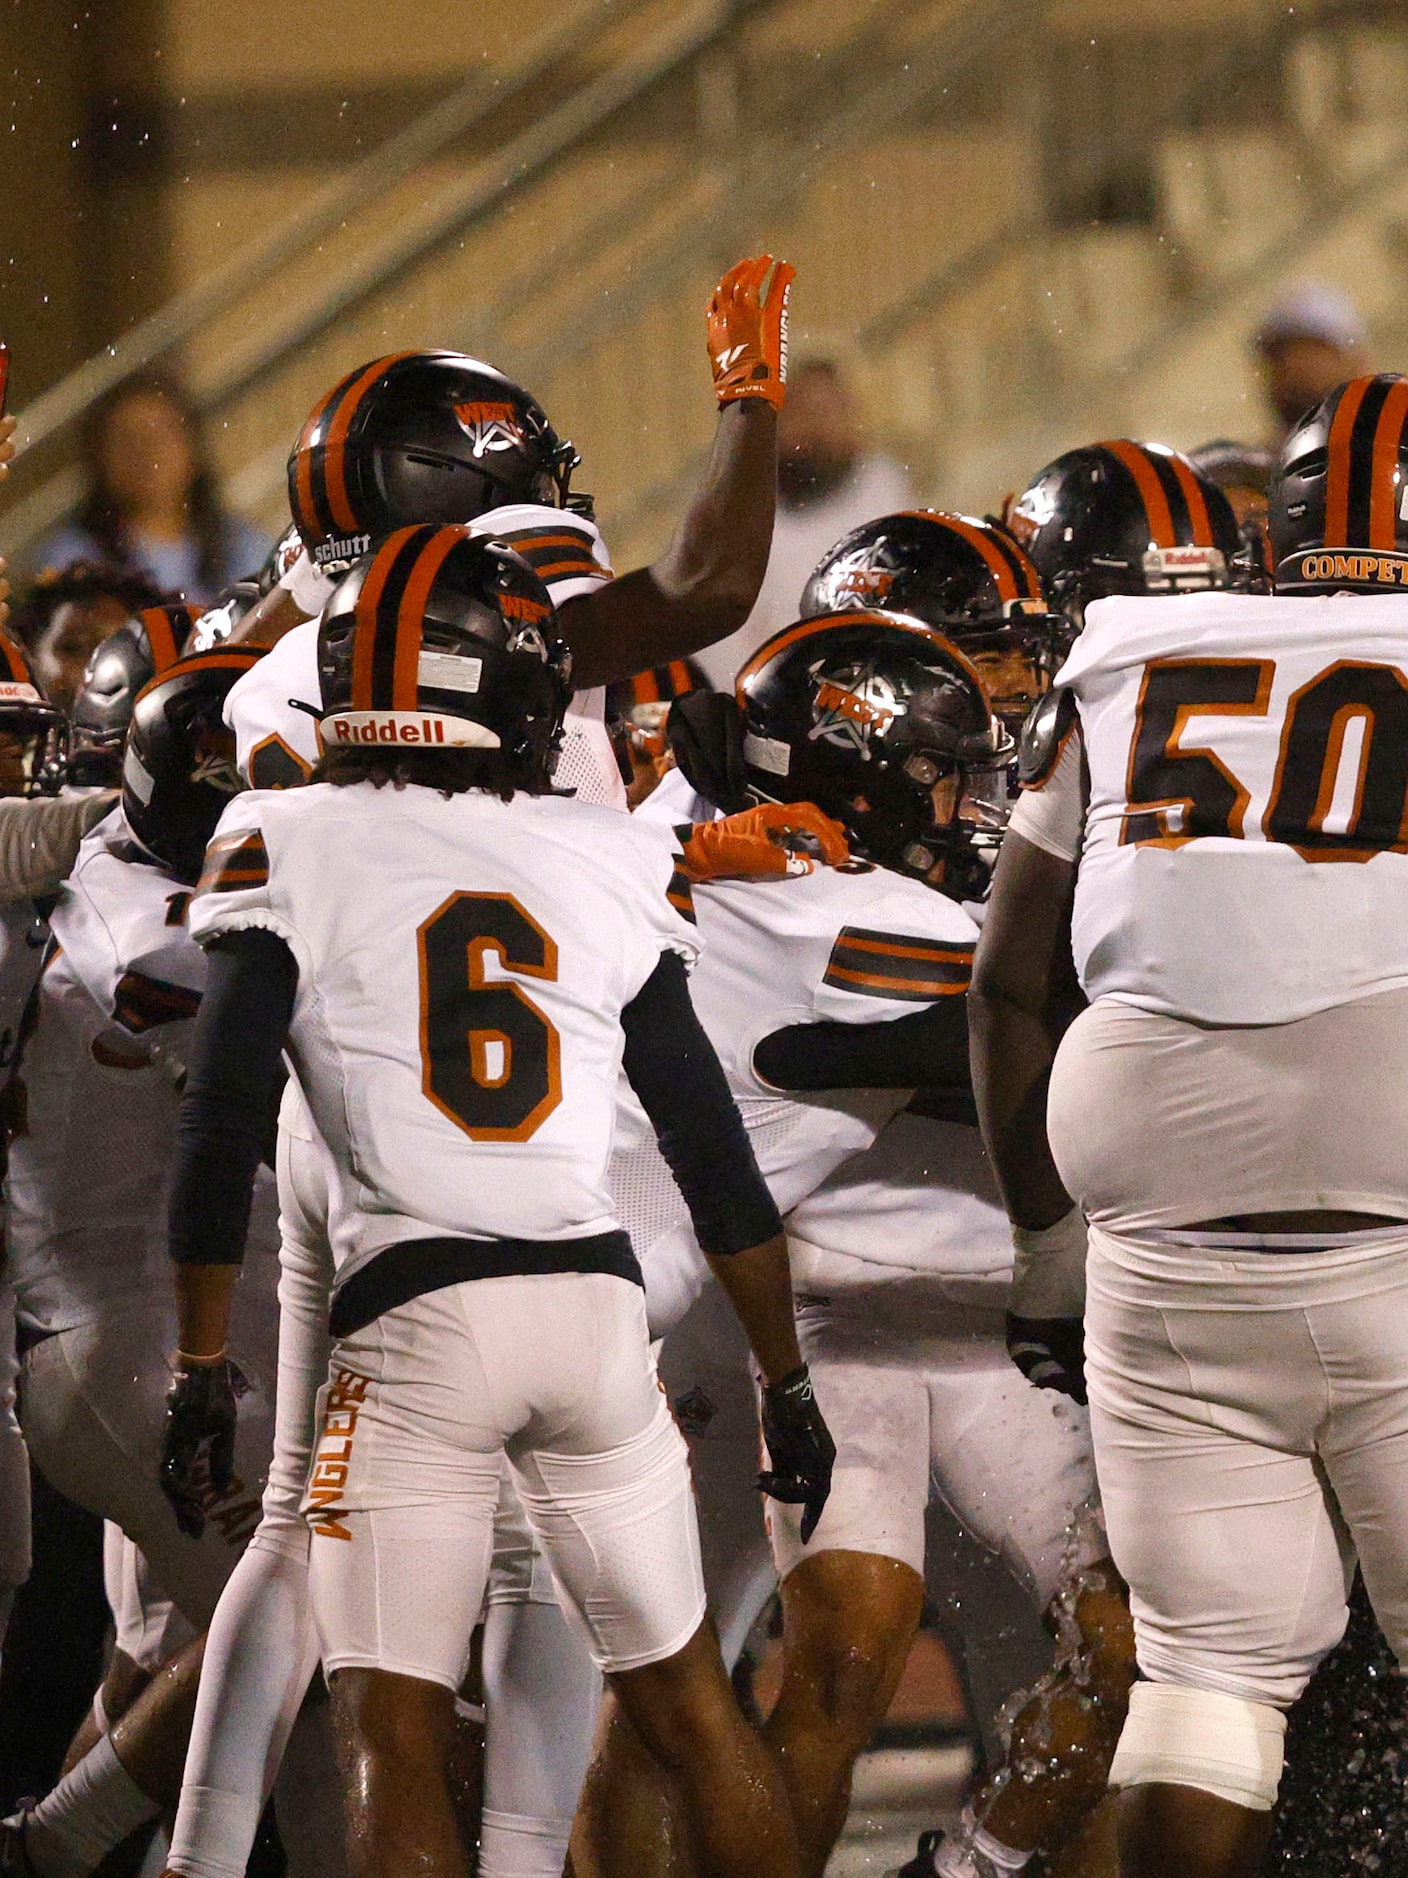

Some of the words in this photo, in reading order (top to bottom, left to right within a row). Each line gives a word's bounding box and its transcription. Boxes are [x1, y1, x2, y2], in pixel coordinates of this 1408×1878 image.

[315, 534, 371, 562] schutt
[334, 719, 445, 744] Riddell
[416, 889, 562, 1142] 6
